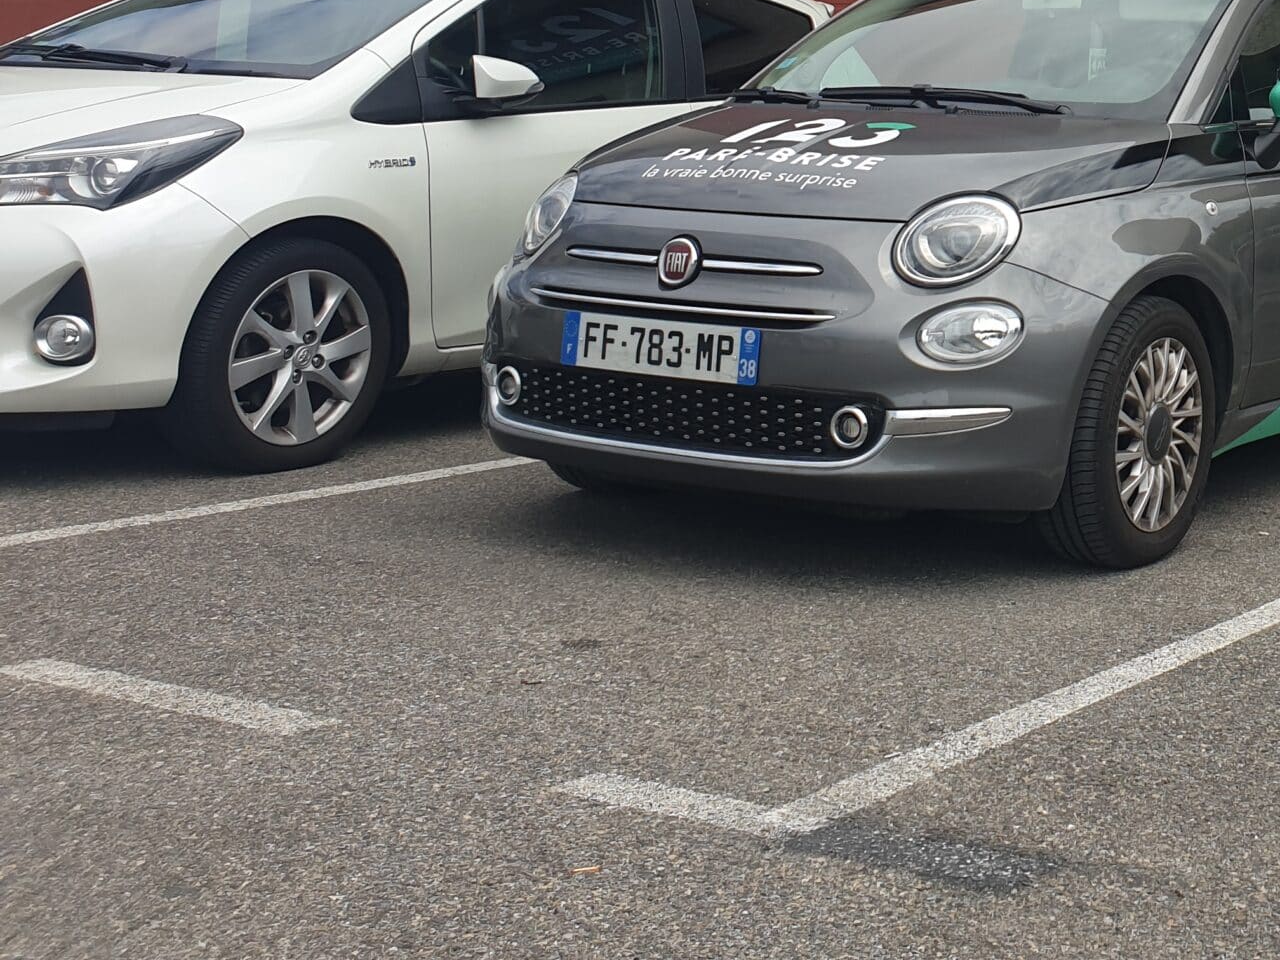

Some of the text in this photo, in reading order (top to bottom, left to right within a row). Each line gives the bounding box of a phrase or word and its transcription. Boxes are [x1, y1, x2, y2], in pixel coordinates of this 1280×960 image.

[720, 118, 917, 148] 123
[368, 158, 409, 169] HYBRID
[662, 146, 885, 171] PARE-BRISE
[641, 164, 857, 190] la vraie bonne surprise
[665, 252, 689, 273] FIAT
[566, 343, 573, 354] F
[738, 358, 757, 379] 38
